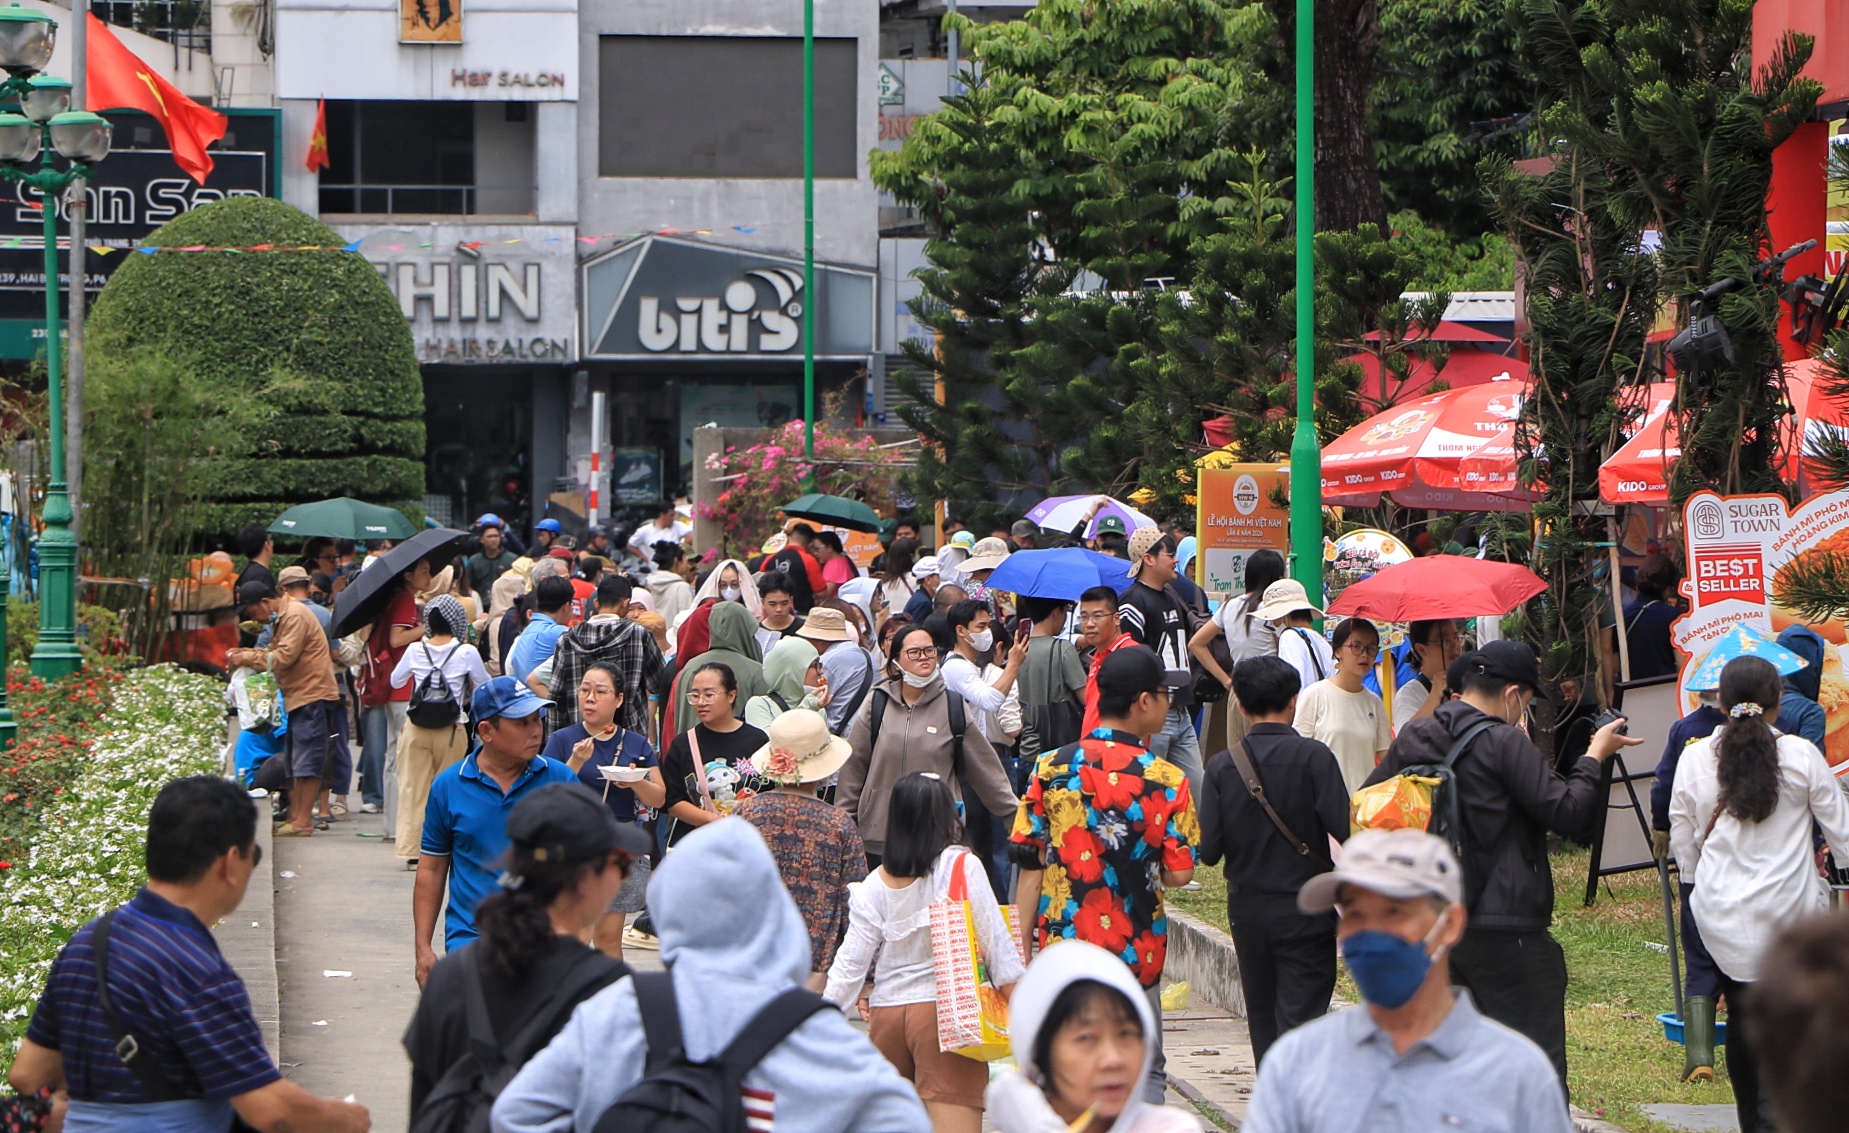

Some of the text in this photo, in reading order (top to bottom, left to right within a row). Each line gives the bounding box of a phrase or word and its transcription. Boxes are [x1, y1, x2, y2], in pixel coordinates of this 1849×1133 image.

[498, 72, 565, 87] SALON
[425, 336, 568, 358] HAIR SALON
[1345, 474, 1363, 484] KIDO
[1380, 470, 1397, 480] KIDO
[1617, 481, 1647, 492] KIDO
[1729, 503, 1780, 518] SUGAR
[1229, 516, 1246, 527] BÁNH
[1268, 519, 1282, 528] NAM
[1730, 518, 1781, 534] TOWN
[1772, 524, 1800, 552] BÁNH
[1800, 513, 1814, 529] MÌ
[1814, 502, 1838, 520] PHÔ
[1792, 520, 1829, 548] HOÀNG
[1699, 578, 1761, 592] SELLER
[1680, 625, 1707, 645] BÁNH
[1707, 617, 1720, 630] MÌ
[1721, 612, 1742, 624] PHÔ
[1743, 611, 1764, 620] MAI
